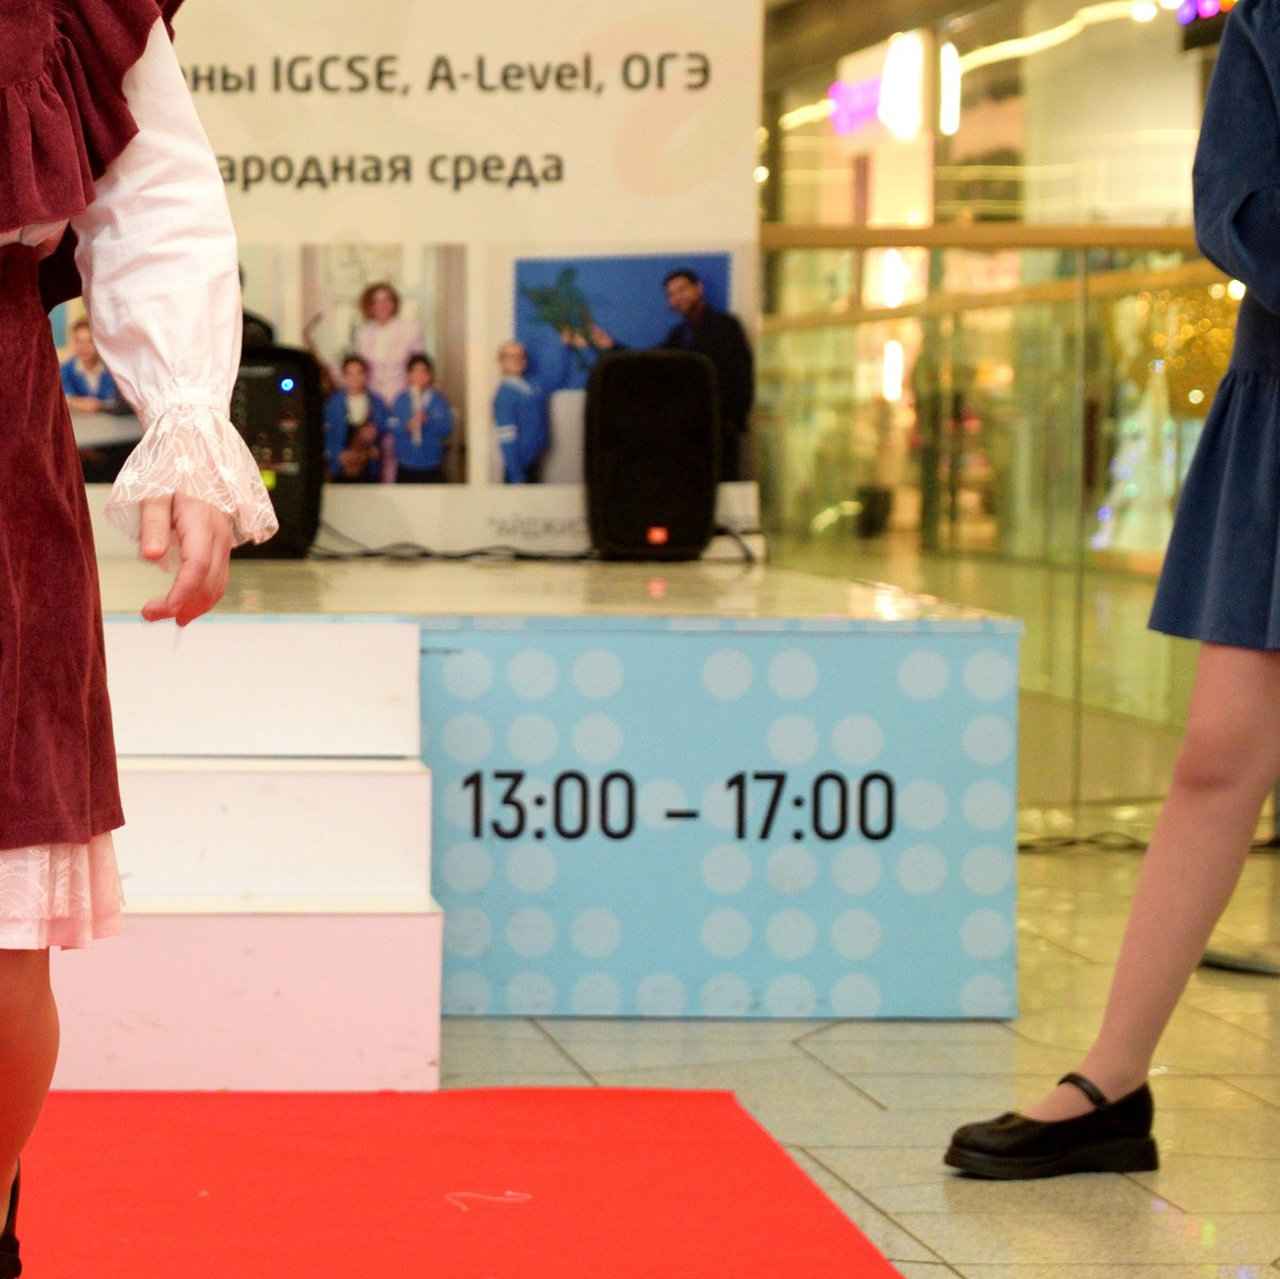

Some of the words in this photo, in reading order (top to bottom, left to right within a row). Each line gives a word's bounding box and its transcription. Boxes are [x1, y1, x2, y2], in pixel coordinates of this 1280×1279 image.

[271, 54, 410, 95] IGCSE,
[426, 53, 605, 95] A-Level,
[620, 51, 712, 91] ОГЭ
[216, 154, 413, 192] ародная
[428, 153, 565, 192] среда
[462, 770, 637, 841] 13:00
[725, 771, 896, 843] 17:00
